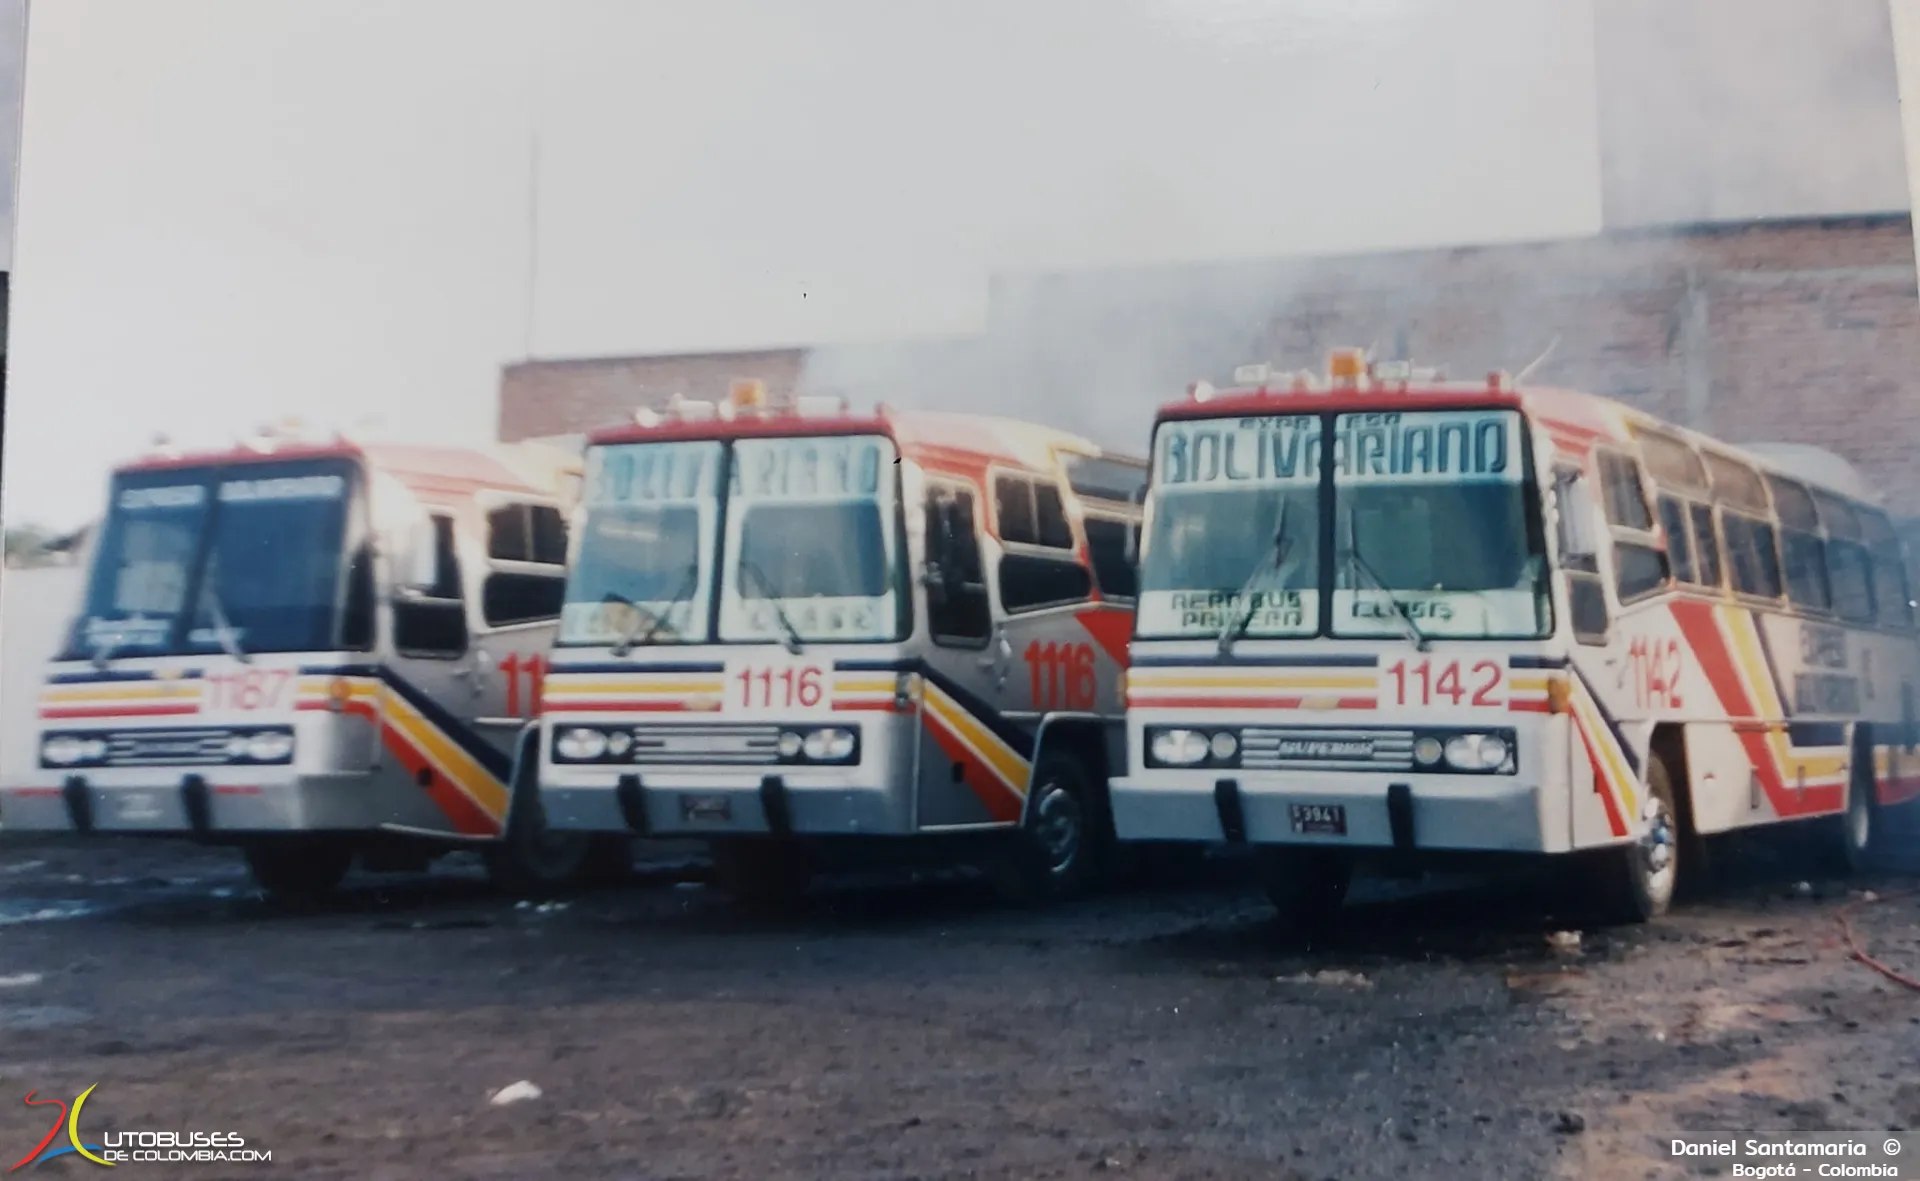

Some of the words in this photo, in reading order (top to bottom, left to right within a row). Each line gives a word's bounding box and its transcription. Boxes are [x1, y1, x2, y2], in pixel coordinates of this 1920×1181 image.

[1163, 418, 1508, 485] BOLIVARIANO
[499, 652, 546, 716] 11
[738, 666, 823, 707] 1116
[1023, 638, 1097, 709] 1116
[1387, 660, 1502, 707] 1142
[1630, 635, 1683, 709] 1142
